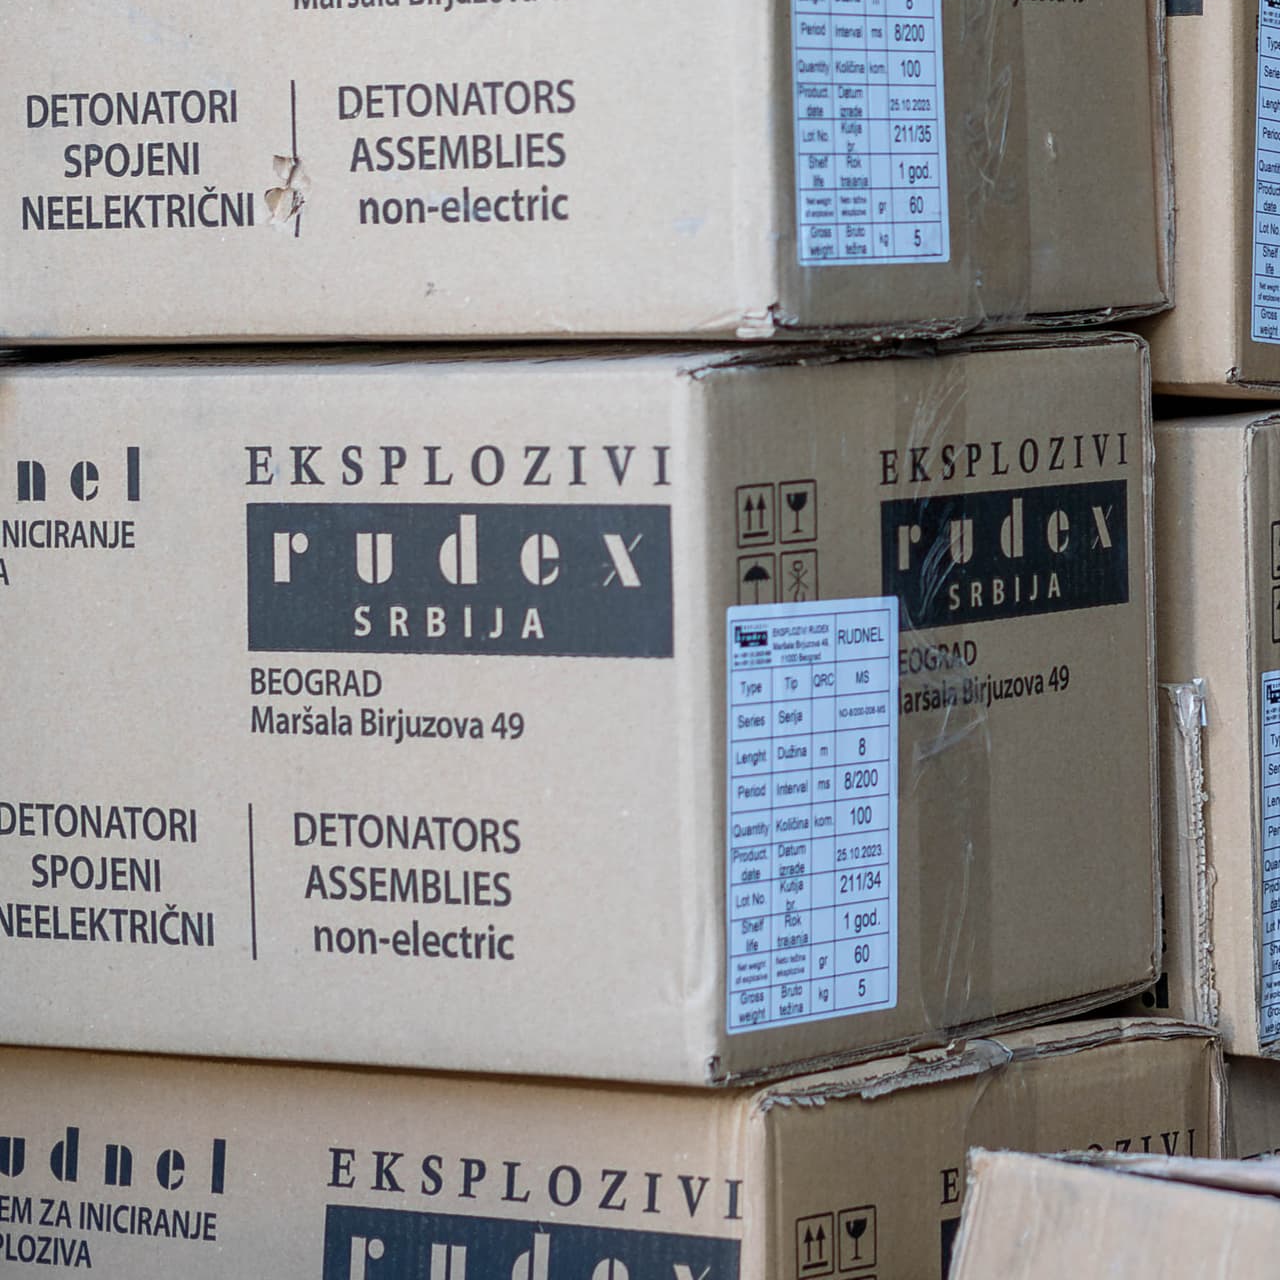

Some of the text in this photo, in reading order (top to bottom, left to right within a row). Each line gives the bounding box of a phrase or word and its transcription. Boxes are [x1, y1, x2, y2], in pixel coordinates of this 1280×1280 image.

[894, 24, 925, 42] 8/200
[26, 88, 239, 129] DETONATORI
[338, 79, 576, 121] DETONATORS
[350, 133, 566, 172] ASSEMBLIES
[894, 125, 932, 143] 211/35
[64, 142, 200, 178] SPOJENI
[22, 185, 256, 230] NEELEKTRIČNI
[358, 186, 569, 225] non-electric
[246, 445, 672, 485] EKSPLOZIVI
[879, 432, 1129, 485] EKSPLOZIVI
[273, 514, 642, 587] rudex
[898, 497, 1113, 572] rudex
[949, 571, 1062, 611] SRBIJA
[354, 605, 544, 640] SRBIJA
[838, 626, 884, 645] RUDNEL
[250, 668, 382, 697] BEOGRAD
[814, 671, 869, 688] QRC MS
[962, 664, 1071, 710] Birjuzova 49
[251, 706, 525, 745] Maršala Birjuzova 49
[859, 738, 866, 756] 8
[844, 769, 878, 790] 8/200
[294, 812, 521, 856] DETONATORS
[850, 806, 872, 825] 100
[31, 854, 161, 892] SPOJENI
[305, 865, 512, 906] ASSEMBLIES
[840, 871, 881, 893] 211/34
[844, 908, 881, 933] 1 god.
[313, 921, 515, 961] non-electric
[854, 944, 870, 964] 60
[858, 978, 866, 997] 5
[328, 1147, 743, 1220] EKSPLOZIVI
[39, 1198, 217, 1242] ZA INICIRANJE
